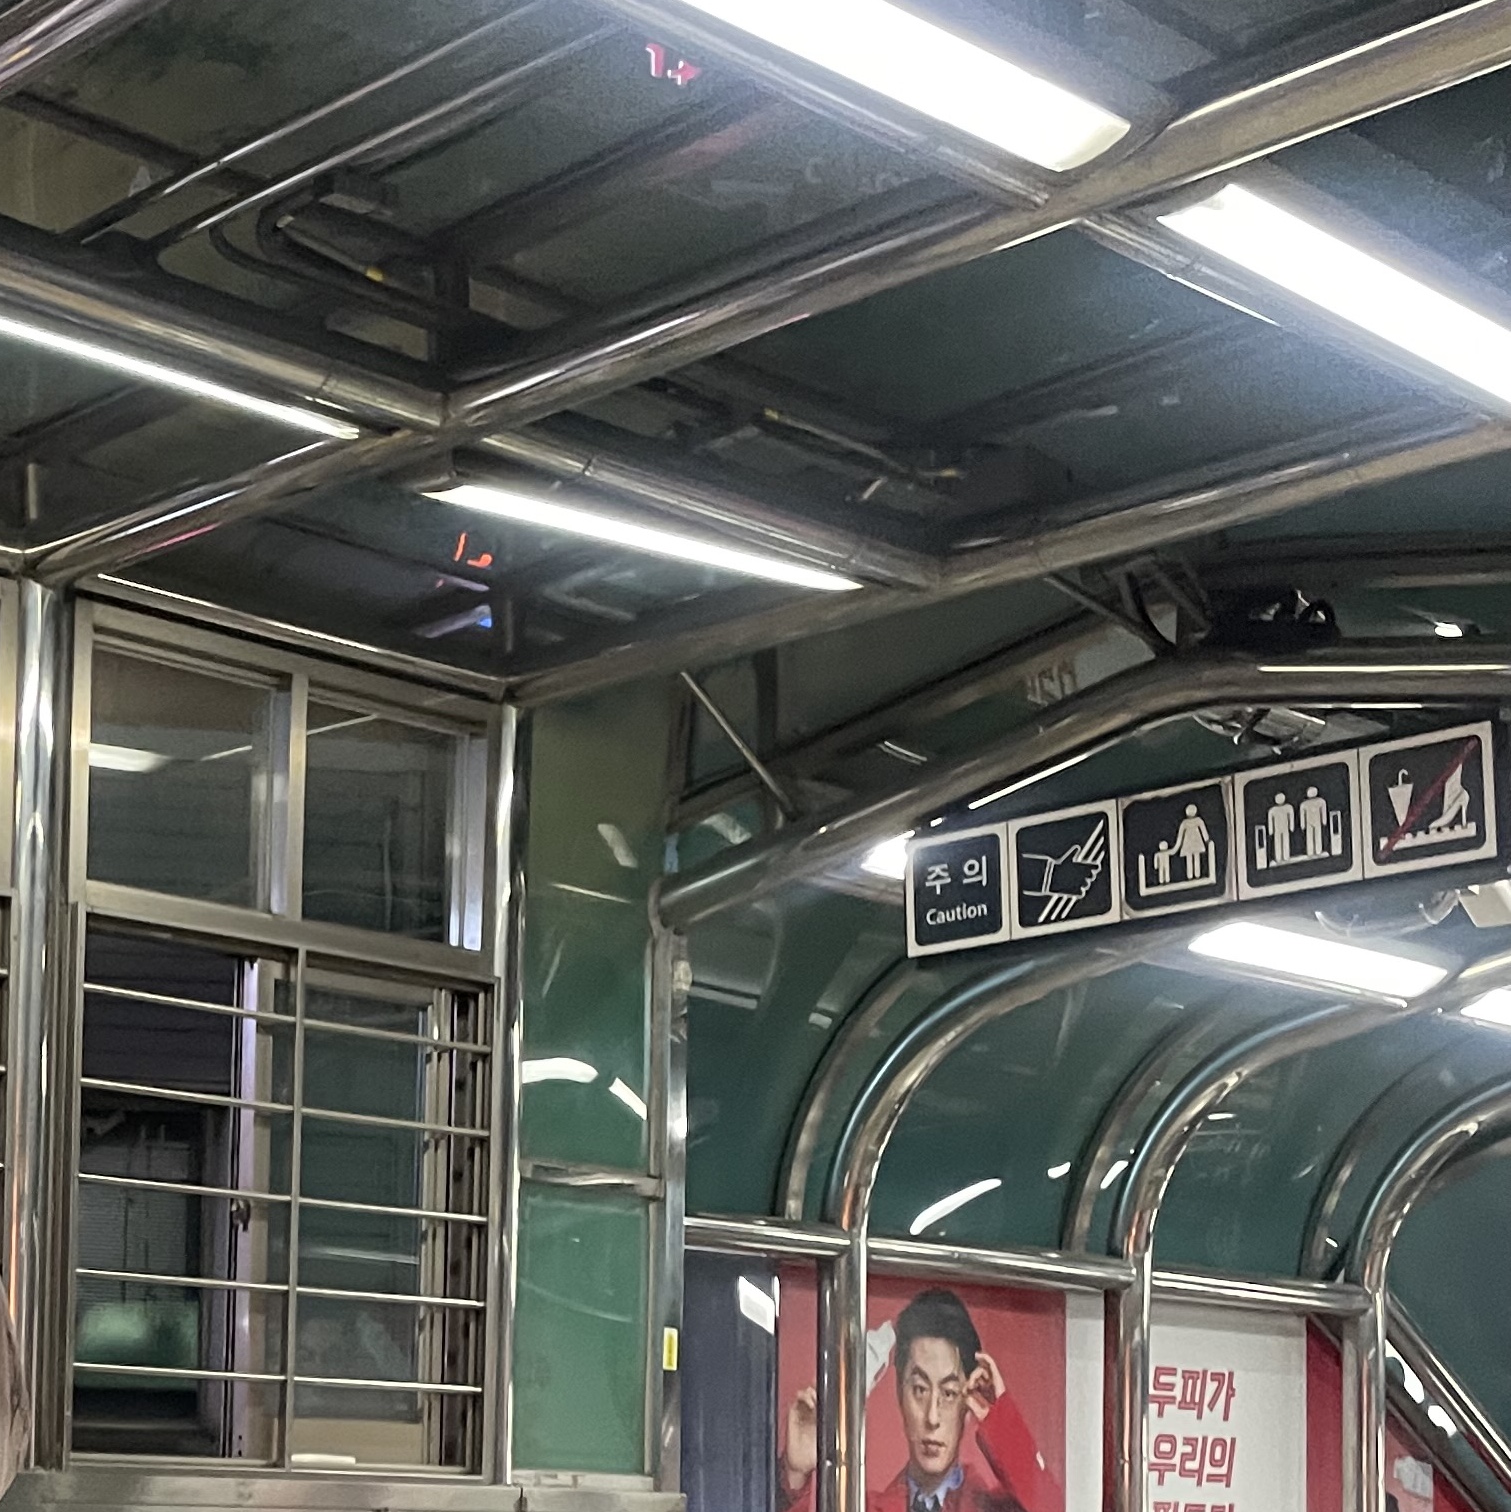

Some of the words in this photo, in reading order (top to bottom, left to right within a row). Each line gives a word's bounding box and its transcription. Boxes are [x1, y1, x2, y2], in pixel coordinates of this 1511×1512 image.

[926, 902, 988, 926] Caution
[1149, 1366, 1236, 1422] 두피가
[1148, 1434, 1236, 1488] 우리의
